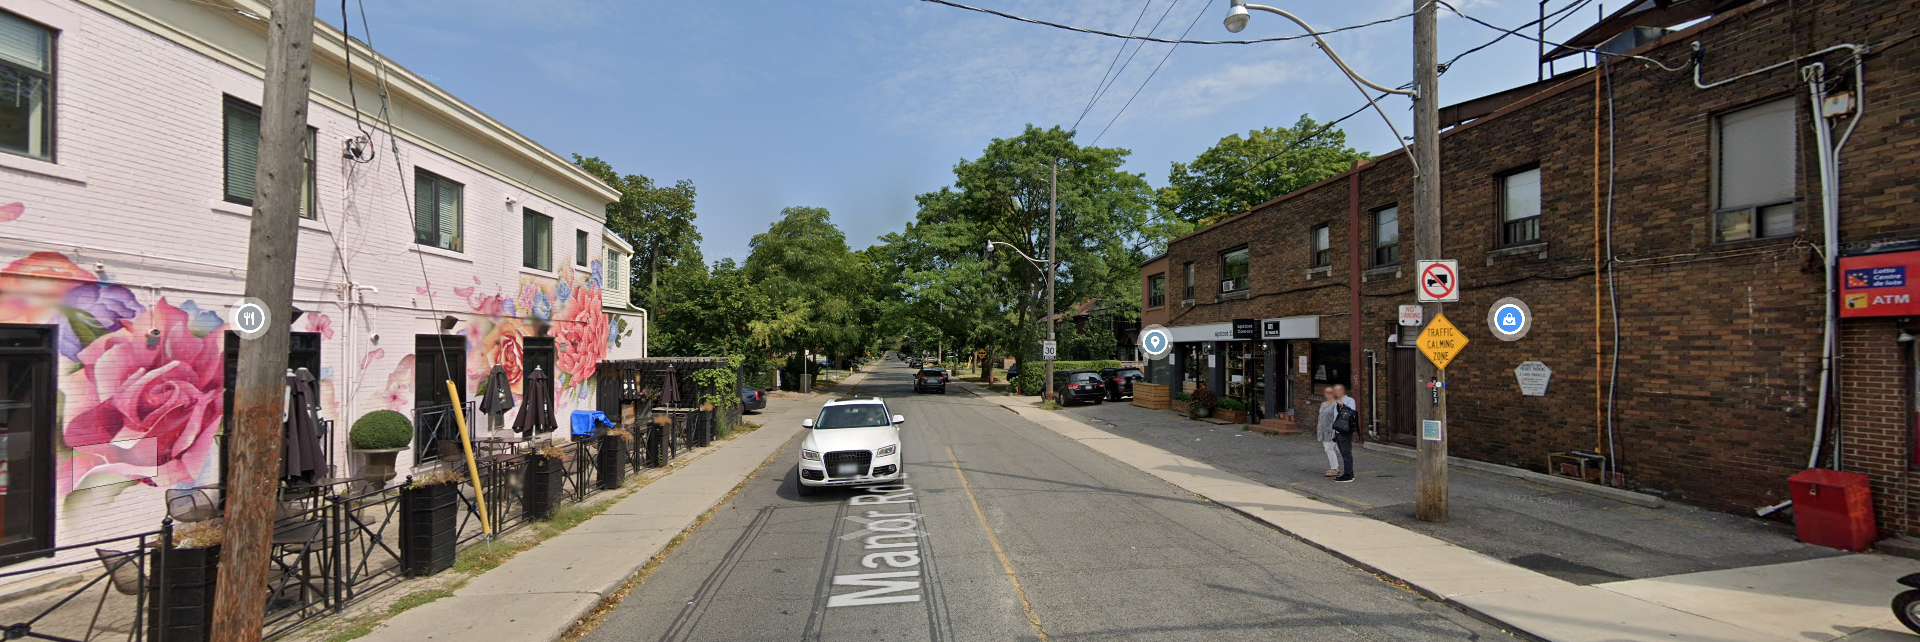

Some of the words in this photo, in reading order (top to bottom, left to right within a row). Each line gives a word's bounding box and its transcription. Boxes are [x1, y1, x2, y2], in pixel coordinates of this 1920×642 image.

[1872, 294, 1911, 305] ATM
[1427, 328, 1453, 337] TRAFFIC
[1427, 340, 1454, 349] CALMING
[1433, 352, 1449, 360] ZONE
